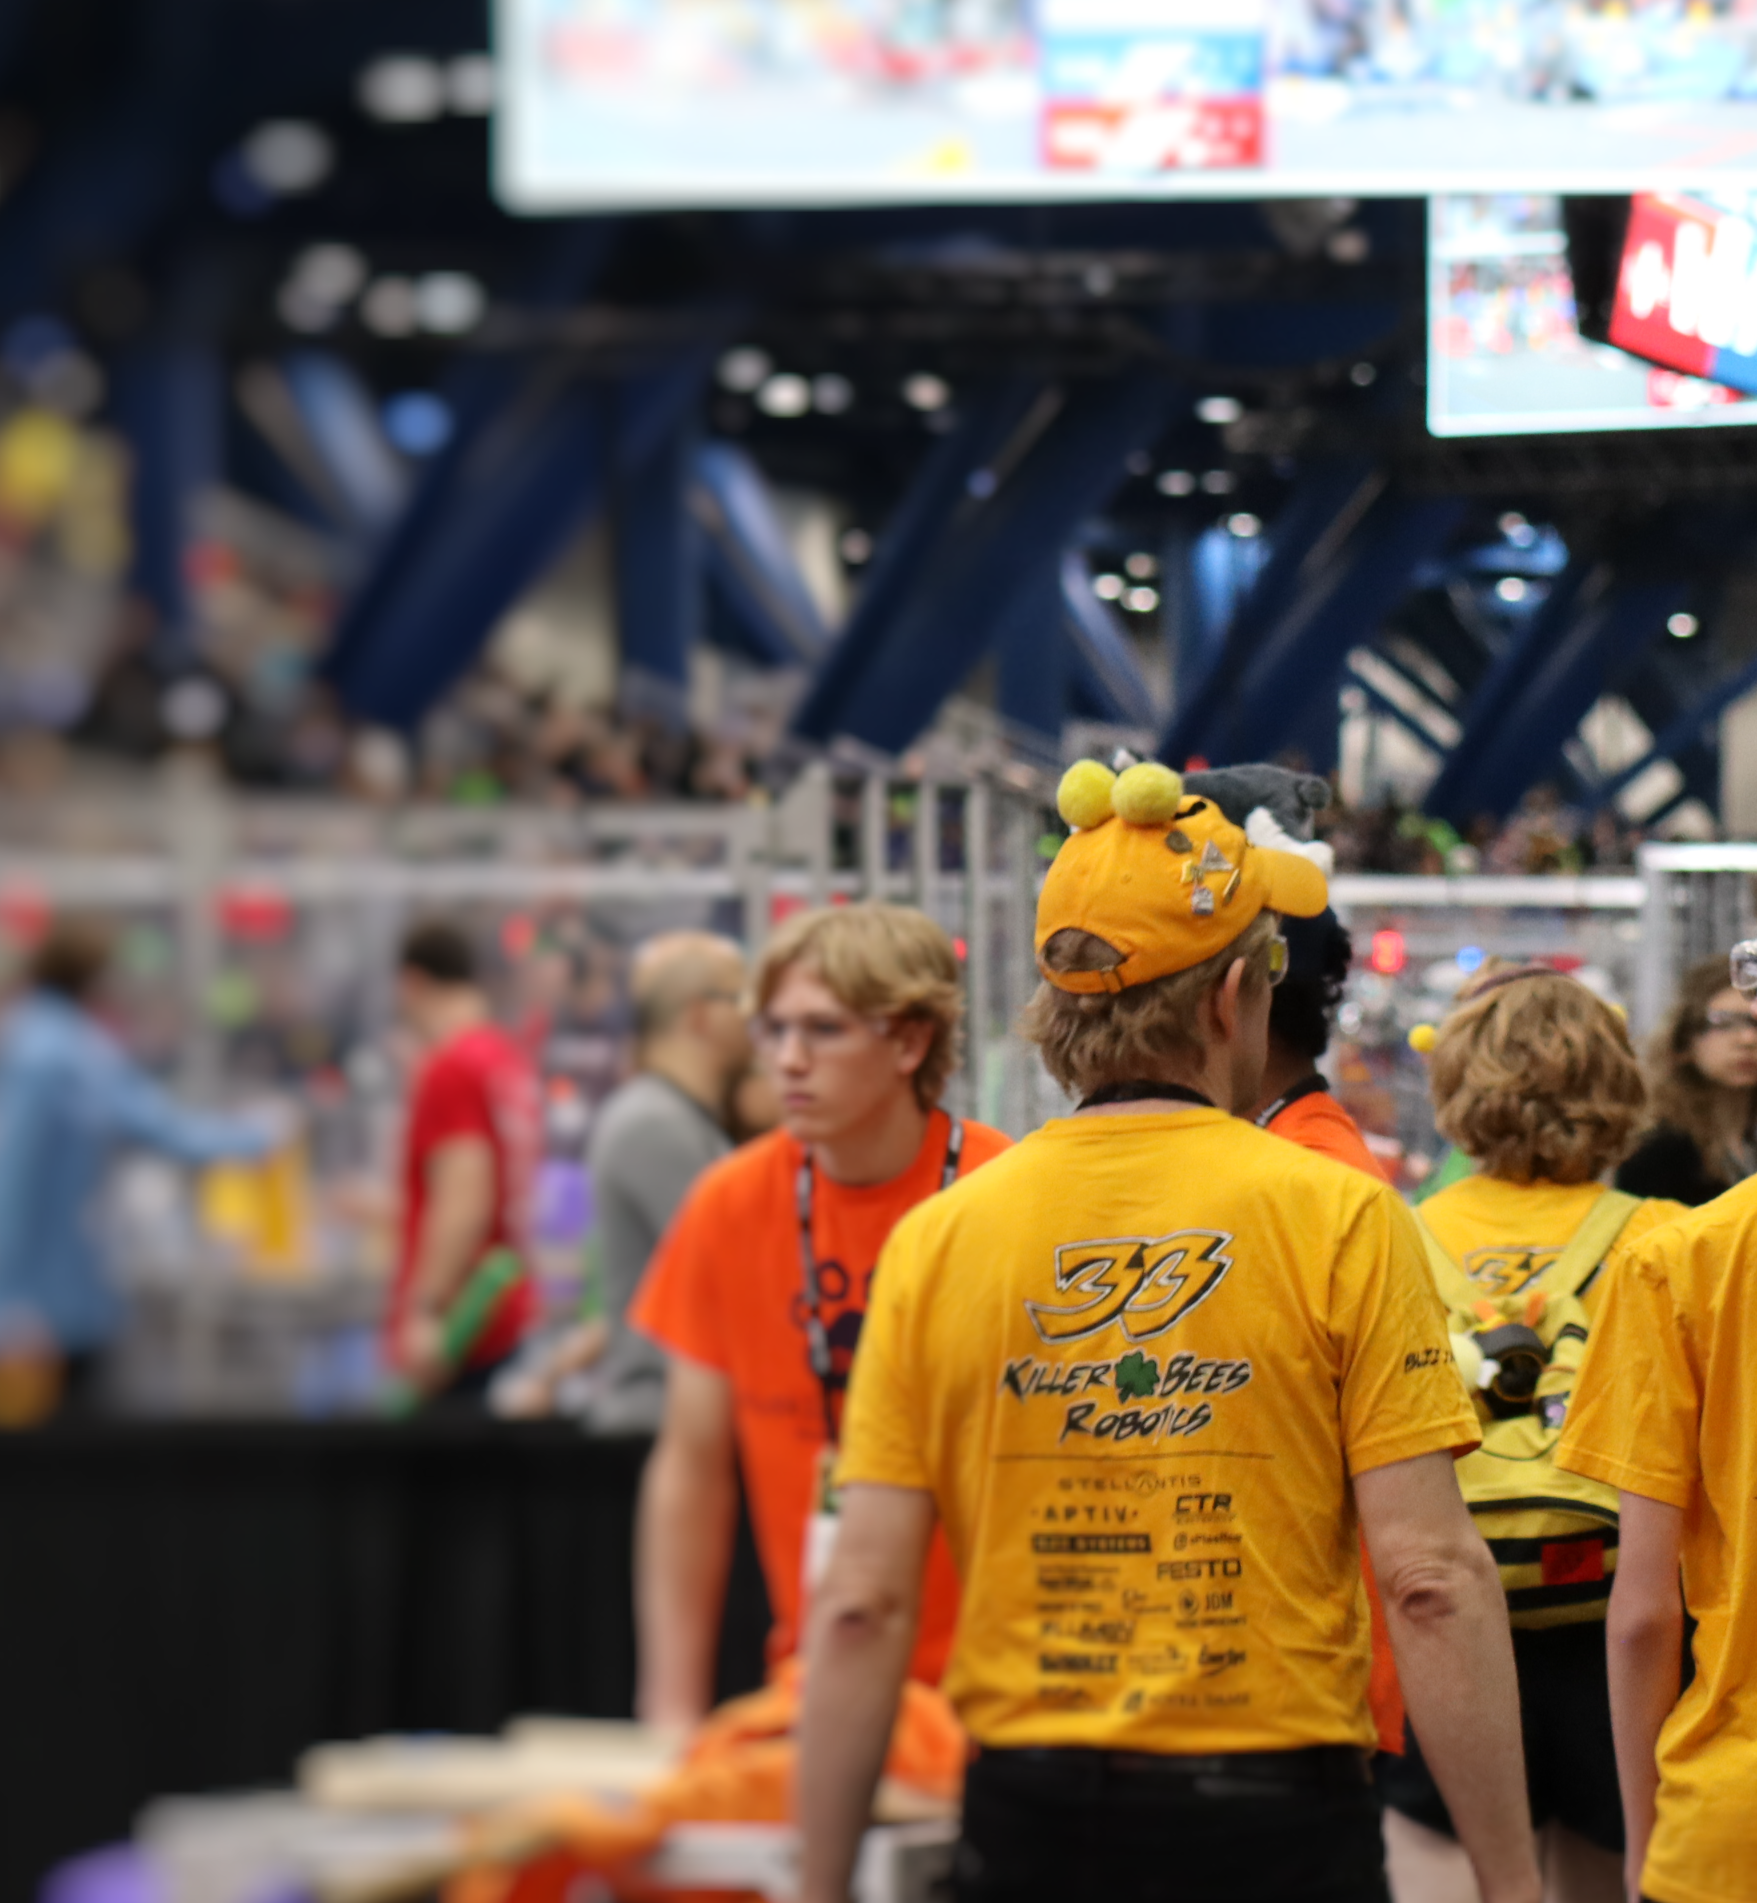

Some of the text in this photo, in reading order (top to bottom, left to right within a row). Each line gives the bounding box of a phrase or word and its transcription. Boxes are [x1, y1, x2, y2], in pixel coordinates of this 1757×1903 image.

[1023, 1228, 1234, 1345] 33
[1058, 1474, 1202, 1492] STELLANTIS
[1175, 1493, 1232, 1513] CTR
[1157, 1558, 1242, 1580] FESTO
